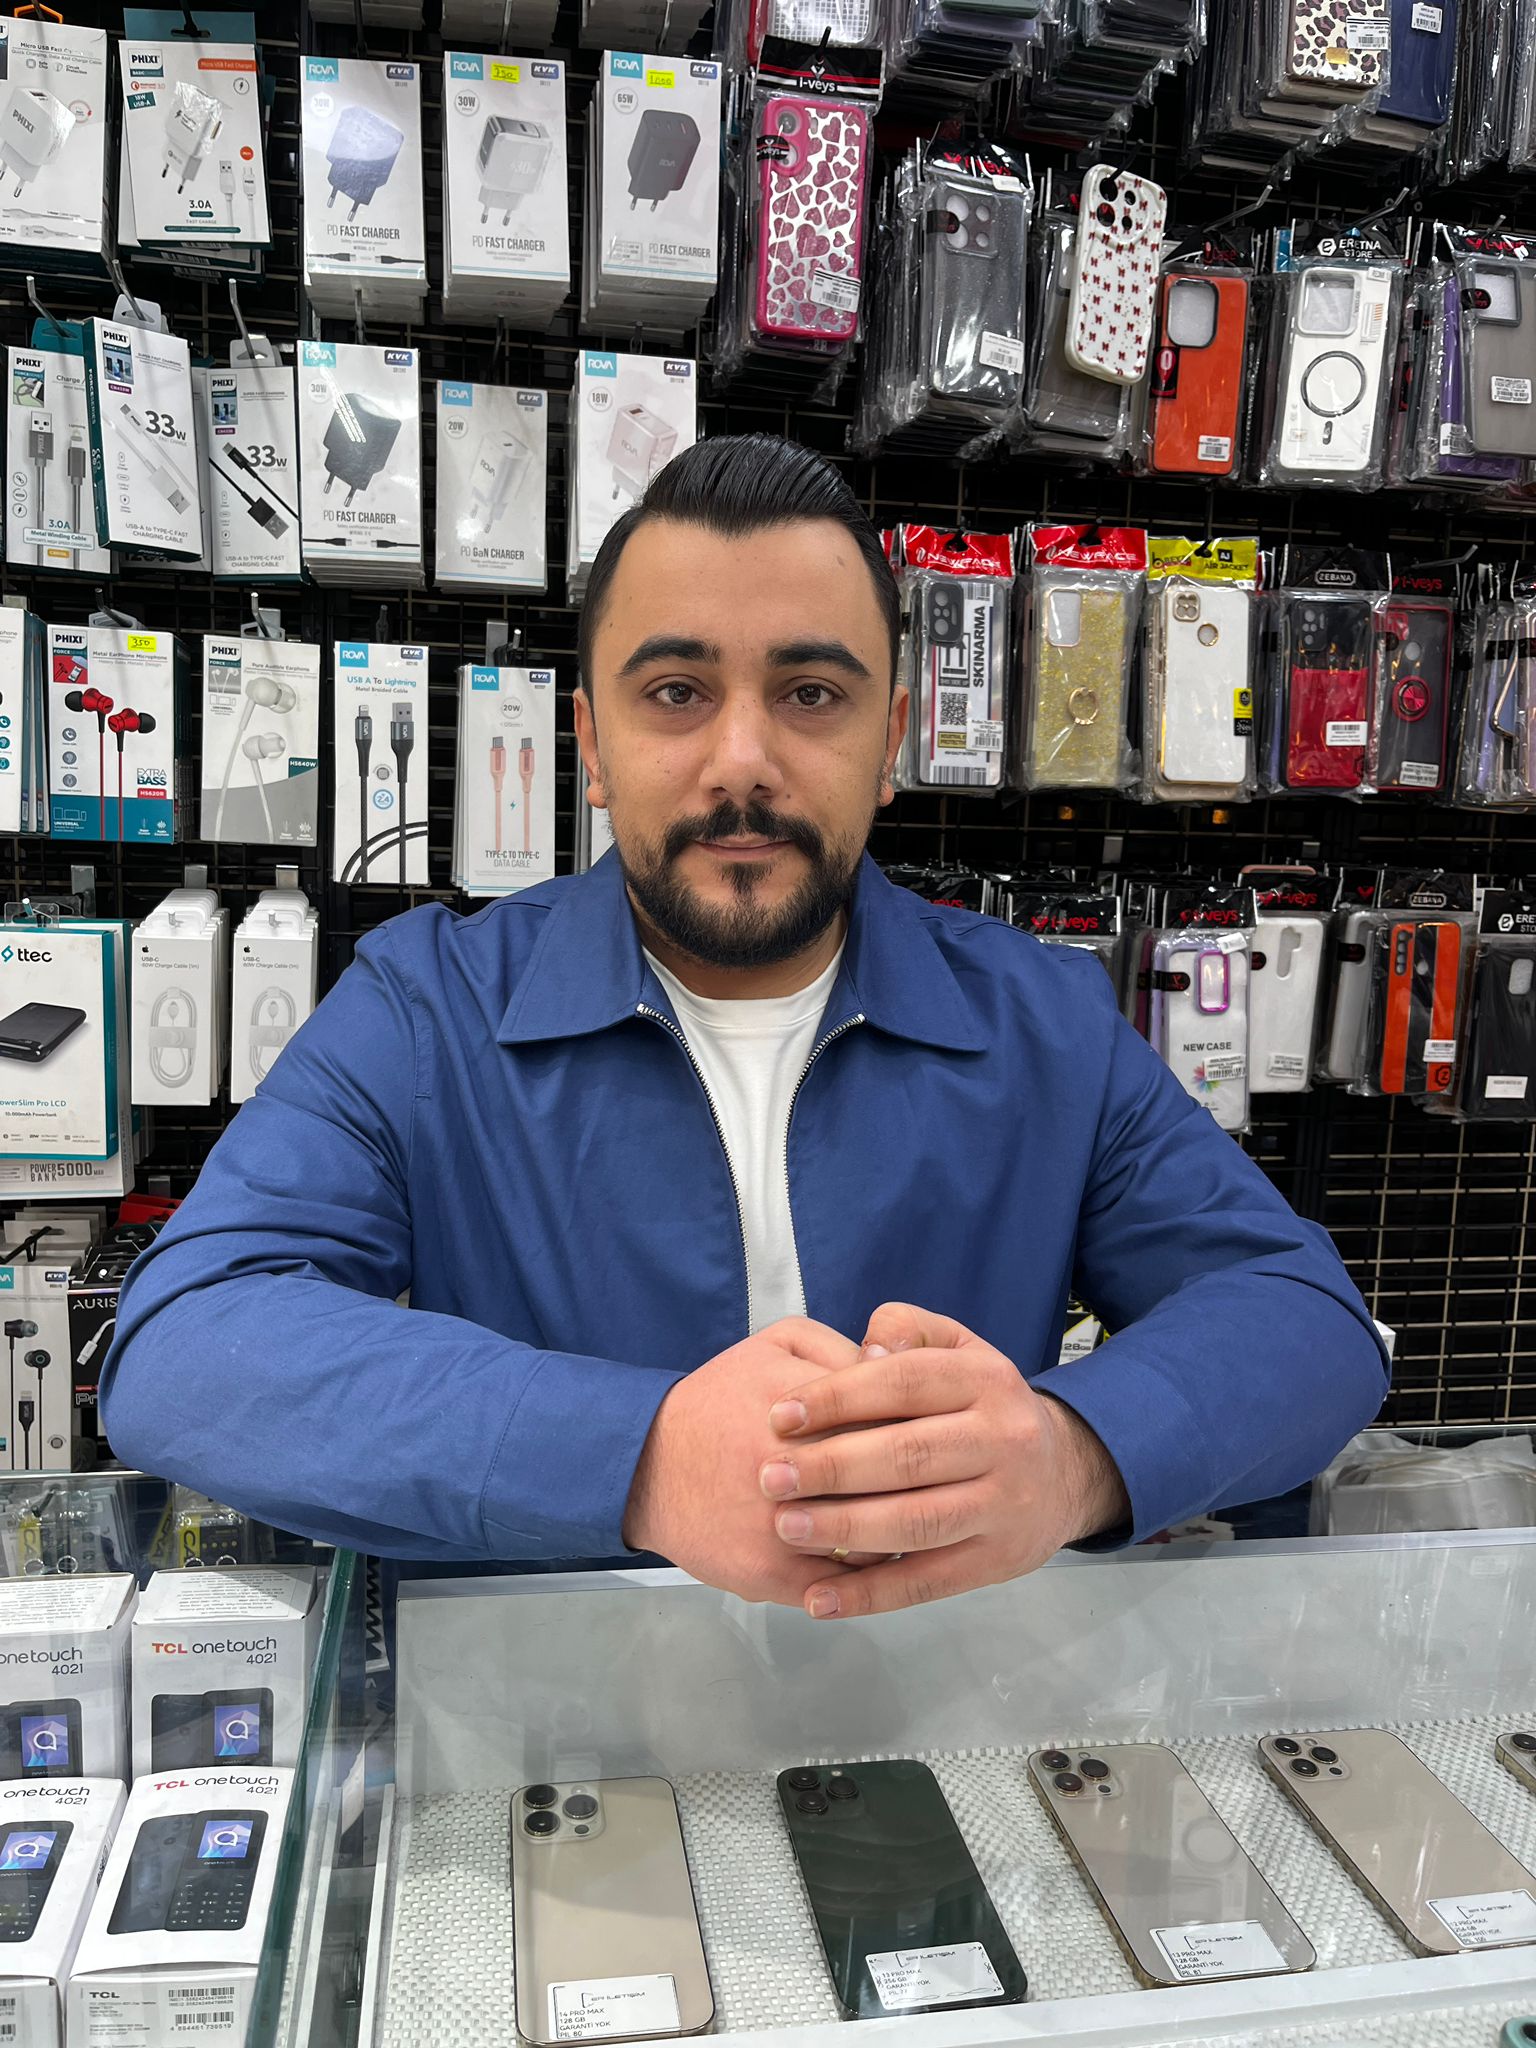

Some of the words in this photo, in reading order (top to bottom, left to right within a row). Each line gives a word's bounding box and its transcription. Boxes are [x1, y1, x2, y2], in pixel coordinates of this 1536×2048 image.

[131, 54, 159, 64] PHIXI
[613, 58, 640, 71] ROVA
[308, 64, 335, 75] ROVA
[389, 67, 411, 75] KVK
[453, 61, 480, 73] ROVA
[533, 65, 556, 74] KVK
[692, 65, 714, 74] KVK
[457, 96, 476, 107] 30W
[617, 93, 634, 104] 65W
[12, 108, 37, 135] PHIXI
[189, 199, 212, 209] 3.0A
[327, 224, 338, 237] PD
[340, 224, 360, 238] FAST
[361, 226, 401, 240] CHARGER
[472, 235, 484, 247] PD
[485, 237, 506, 249] FAST
[507, 238, 546, 252] CHARGER
[1339, 238, 1382, 250] ERETNA
[648, 242, 659, 253] PD
[660, 243, 677, 255] FAST
[678, 245, 711, 259] CHARGER
[1343, 249, 1373, 259] STORE
[103, 330, 128, 343] PHIXI
[387, 352, 410, 361] KVK
[16, 357, 42, 368] PHIXI
[587, 358, 614, 371] ROVA
[665, 363, 688, 372] KVK
[56, 374, 81, 384] Charge
[212, 379, 234, 387] PHIXI
[310, 383, 327, 393] 30W
[445, 388, 470, 400] ROVA
[519, 393, 540, 402] KVK
[592, 392, 609, 404] 18W
[448, 420, 464, 431] 20W
[323, 509, 334, 521] PD
[336, 511, 356, 523] FAST
[358, 512, 397, 525] CHARGER
[48, 519, 71, 530] 3.0A
[30, 530, 47, 538] Metal
[47, 532, 71, 541] Winding
[70, 534, 87, 542] Cable
[125, 523, 145, 531] USB-A
[152, 527, 173, 535] TYPE-C
[174, 530, 189, 538] FAST
[132, 530, 164, 541] CHARGING
[164, 535, 184, 544] CABLE
[460, 545, 471, 557] PD
[472, 546, 489, 559] GaN
[490, 547, 525, 561] CHARGER
[1319, 573, 1352, 582] ZEBANA
[55, 634, 84, 644] PHIXI
[133, 638, 151, 647] 350
[211, 645, 239, 656] PHIXI
[973, 605, 986, 688] SKINARMA
[342, 650, 366, 660] ROVA
[346, 675, 363, 684] USB
[364, 676, 371, 684] A
[373, 677, 382, 685] To
[384, 677, 417, 688] Lightning
[474, 673, 497, 683] ROVA
[503, 704, 521, 712] 20W
[289, 760, 317, 768] HS640W
[136, 767, 167, 778] EXTRA
[136, 775, 167, 786] BASS
[485, 850, 508, 859] TYPE-C
[508, 851, 517, 859] TO
[517, 851, 540, 860] TYPE-C
[493, 859, 511, 868] DATA
[511, 859, 531, 868] CABLE
[17, 947, 53, 963] ttec
[154, 962, 173, 970] Charge
[1182, 1043, 1205, 1052] NEW
[1206, 1041, 1232, 1051] CASE
[0, 1098, 35, 1107] owerSlim
[36, 1099, 49, 1107] Pro
[50, 1099, 67, 1107] LCD
[29, 1163, 57, 1173] POWER
[57, 1161, 93, 1177] 5000
[30, 1172, 57, 1182] BANK
[72, 1297, 118, 1310] AURIS
[152, 1641, 189, 1654] TCL
[246, 1652, 278, 1664] 4021
[51, 1663, 84, 1676] 4021
[153, 1780, 190, 1791] TCL
[246, 1785, 278, 1796] 4021
[54, 1796, 88, 1806] 4021
[89, 1991, 121, 1999] TCL
[569, 2009, 586, 2017] PRO
[586, 2007, 605, 2015] MAX
[559, 2021, 594, 2031] GARANTİ
[594, 2020, 612, 2028] YOK
